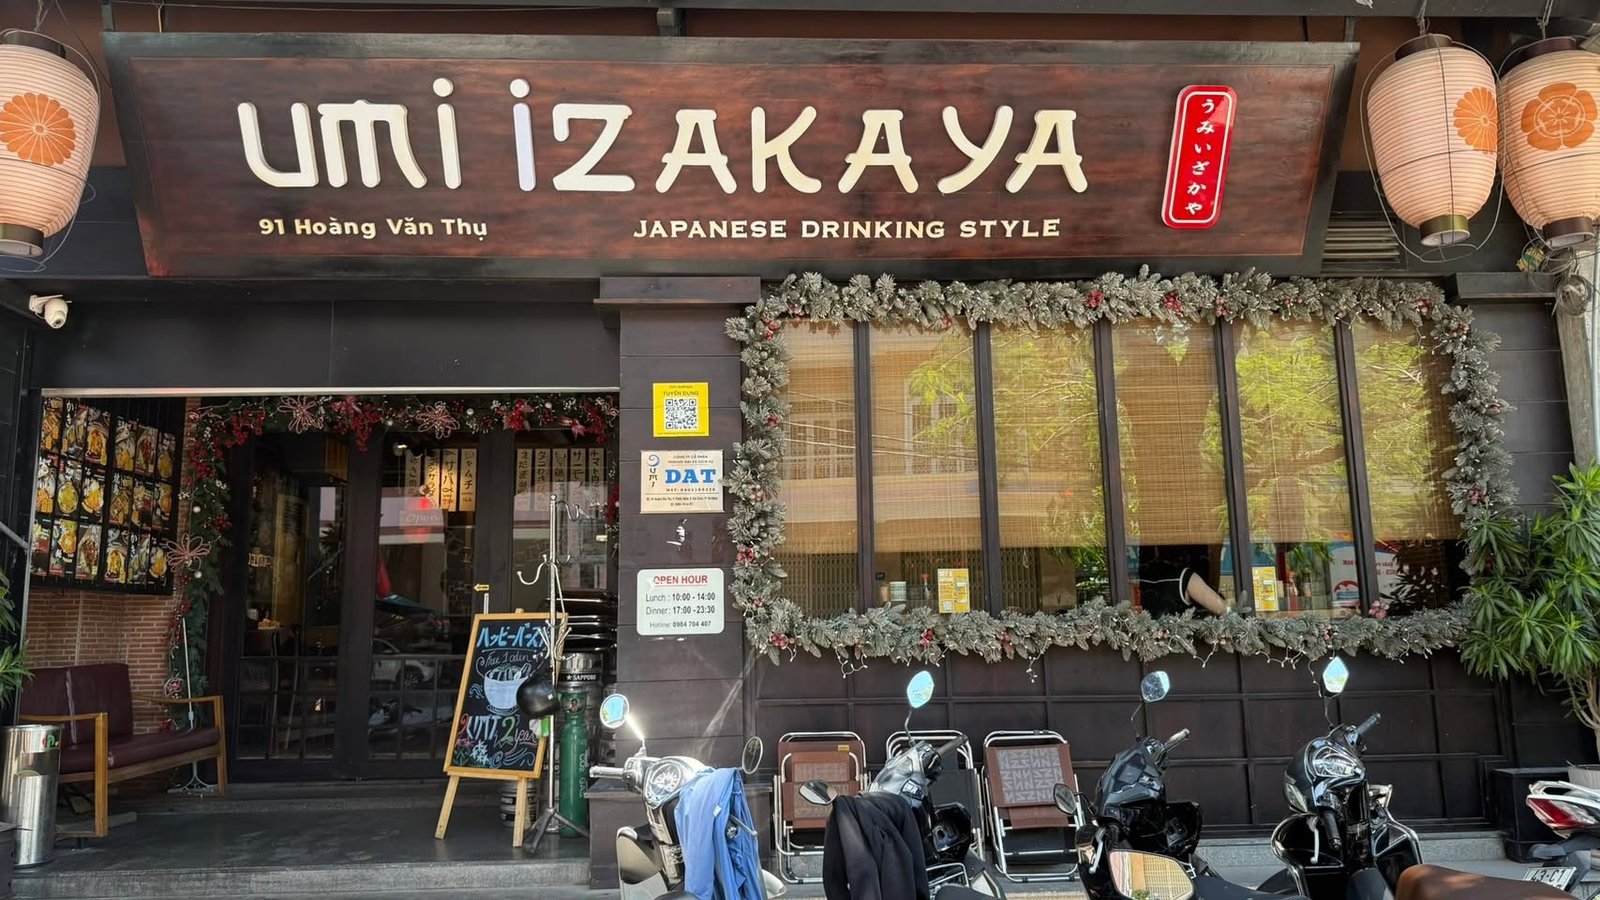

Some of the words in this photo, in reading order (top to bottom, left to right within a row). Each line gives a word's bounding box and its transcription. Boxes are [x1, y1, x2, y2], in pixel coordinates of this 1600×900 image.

[1184, 98, 1216, 215] うみいざかや
[258, 219, 286, 236] 91
[295, 217, 376, 240] Hoàng
[386, 217, 434, 236] Văn
[442, 218, 488, 242] Thụ
[633, 219, 787, 240] JAPANESE
[801, 219, 946, 240] DRINKING
[959, 218, 1061, 239] STYLE
[653, 576, 679, 585] OPEN
[681, 575, 708, 584] HOUR
[672, 593, 691, 601] 10:00
[697, 592, 716, 601] 14:00
[673, 606, 691, 614] 17:00
[696, 605, 716, 614] 23:30
